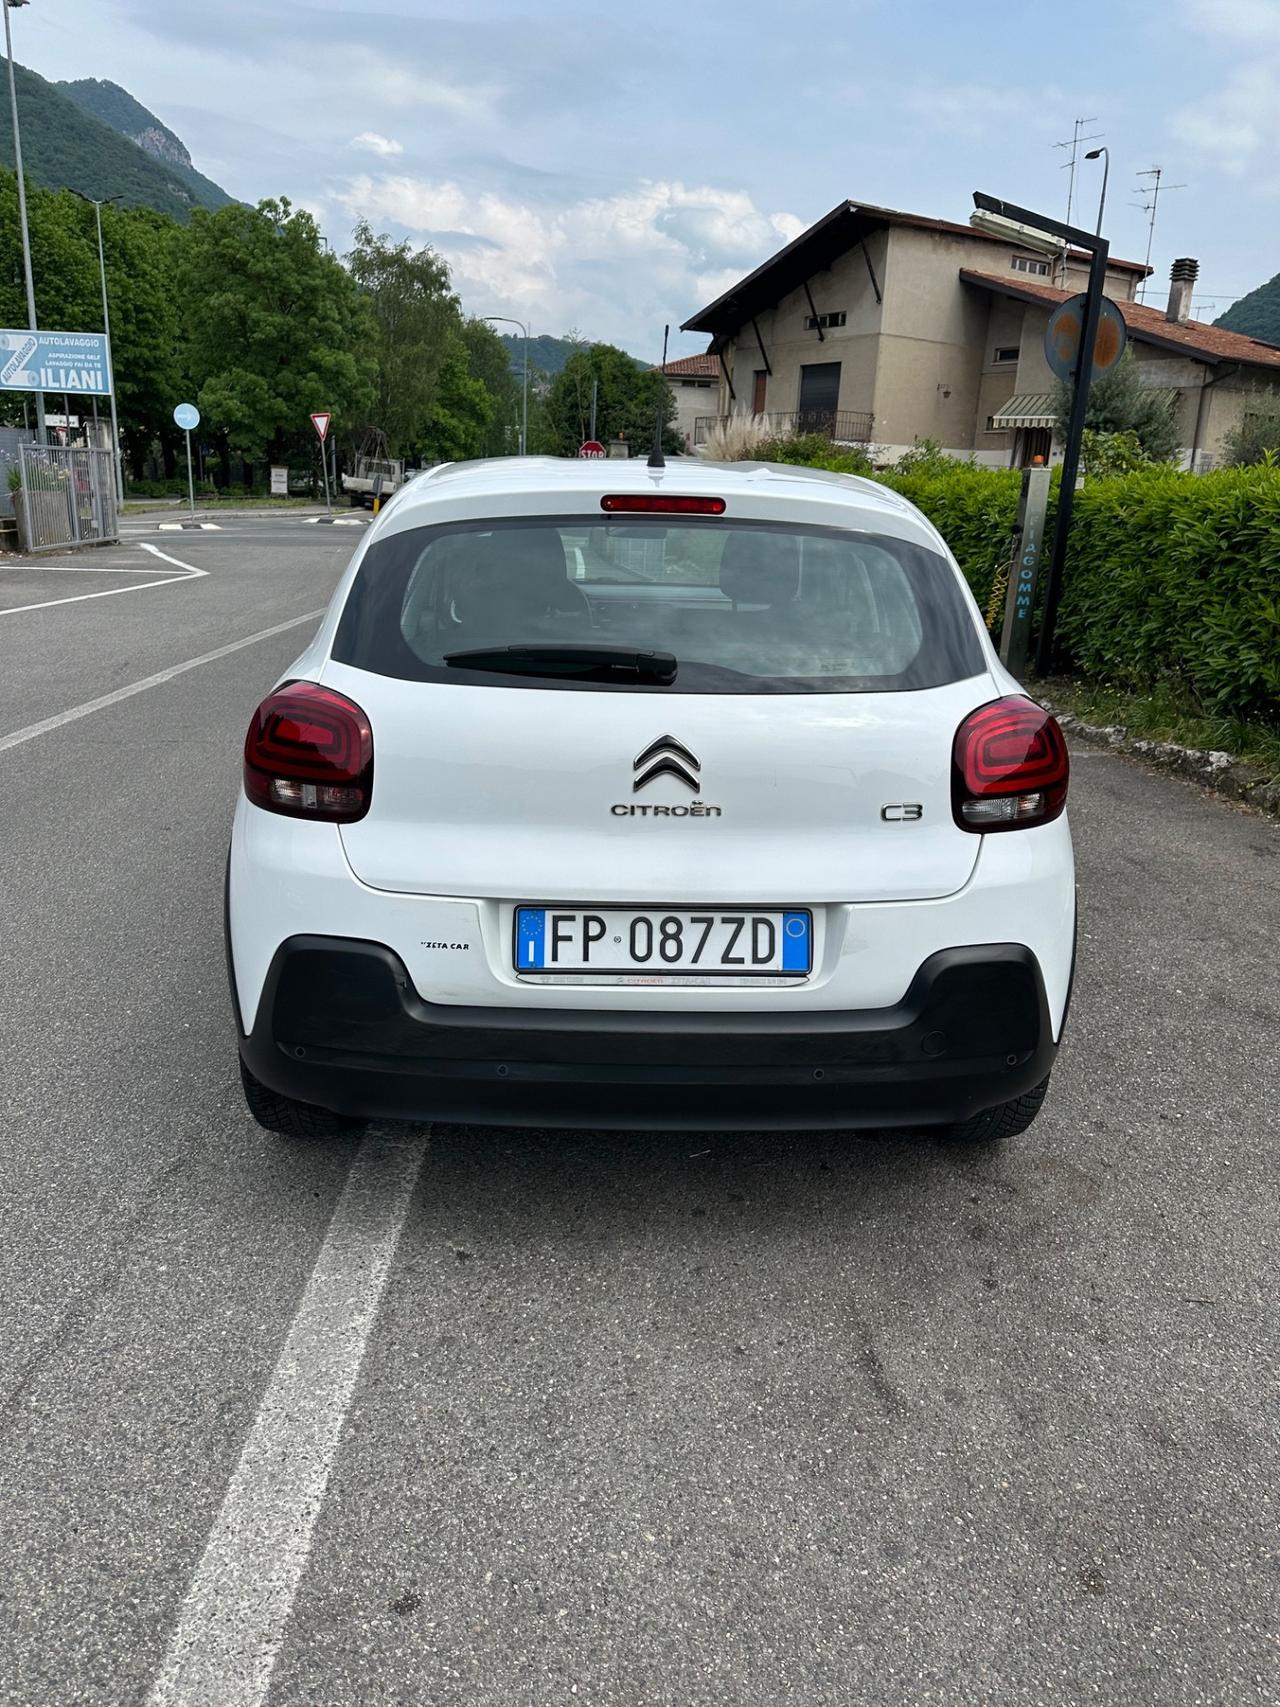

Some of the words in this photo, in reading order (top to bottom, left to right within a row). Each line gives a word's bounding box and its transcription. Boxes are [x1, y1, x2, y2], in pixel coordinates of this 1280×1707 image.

[39, 336, 99, 347] AUTOLAVAGGIO
[581, 450, 604, 458] STOP
[880, 802, 923, 822] C3
[551, 914, 607, 962] FP
[629, 915, 776, 965] 087ZD
[450, 943, 470, 951] CAR
